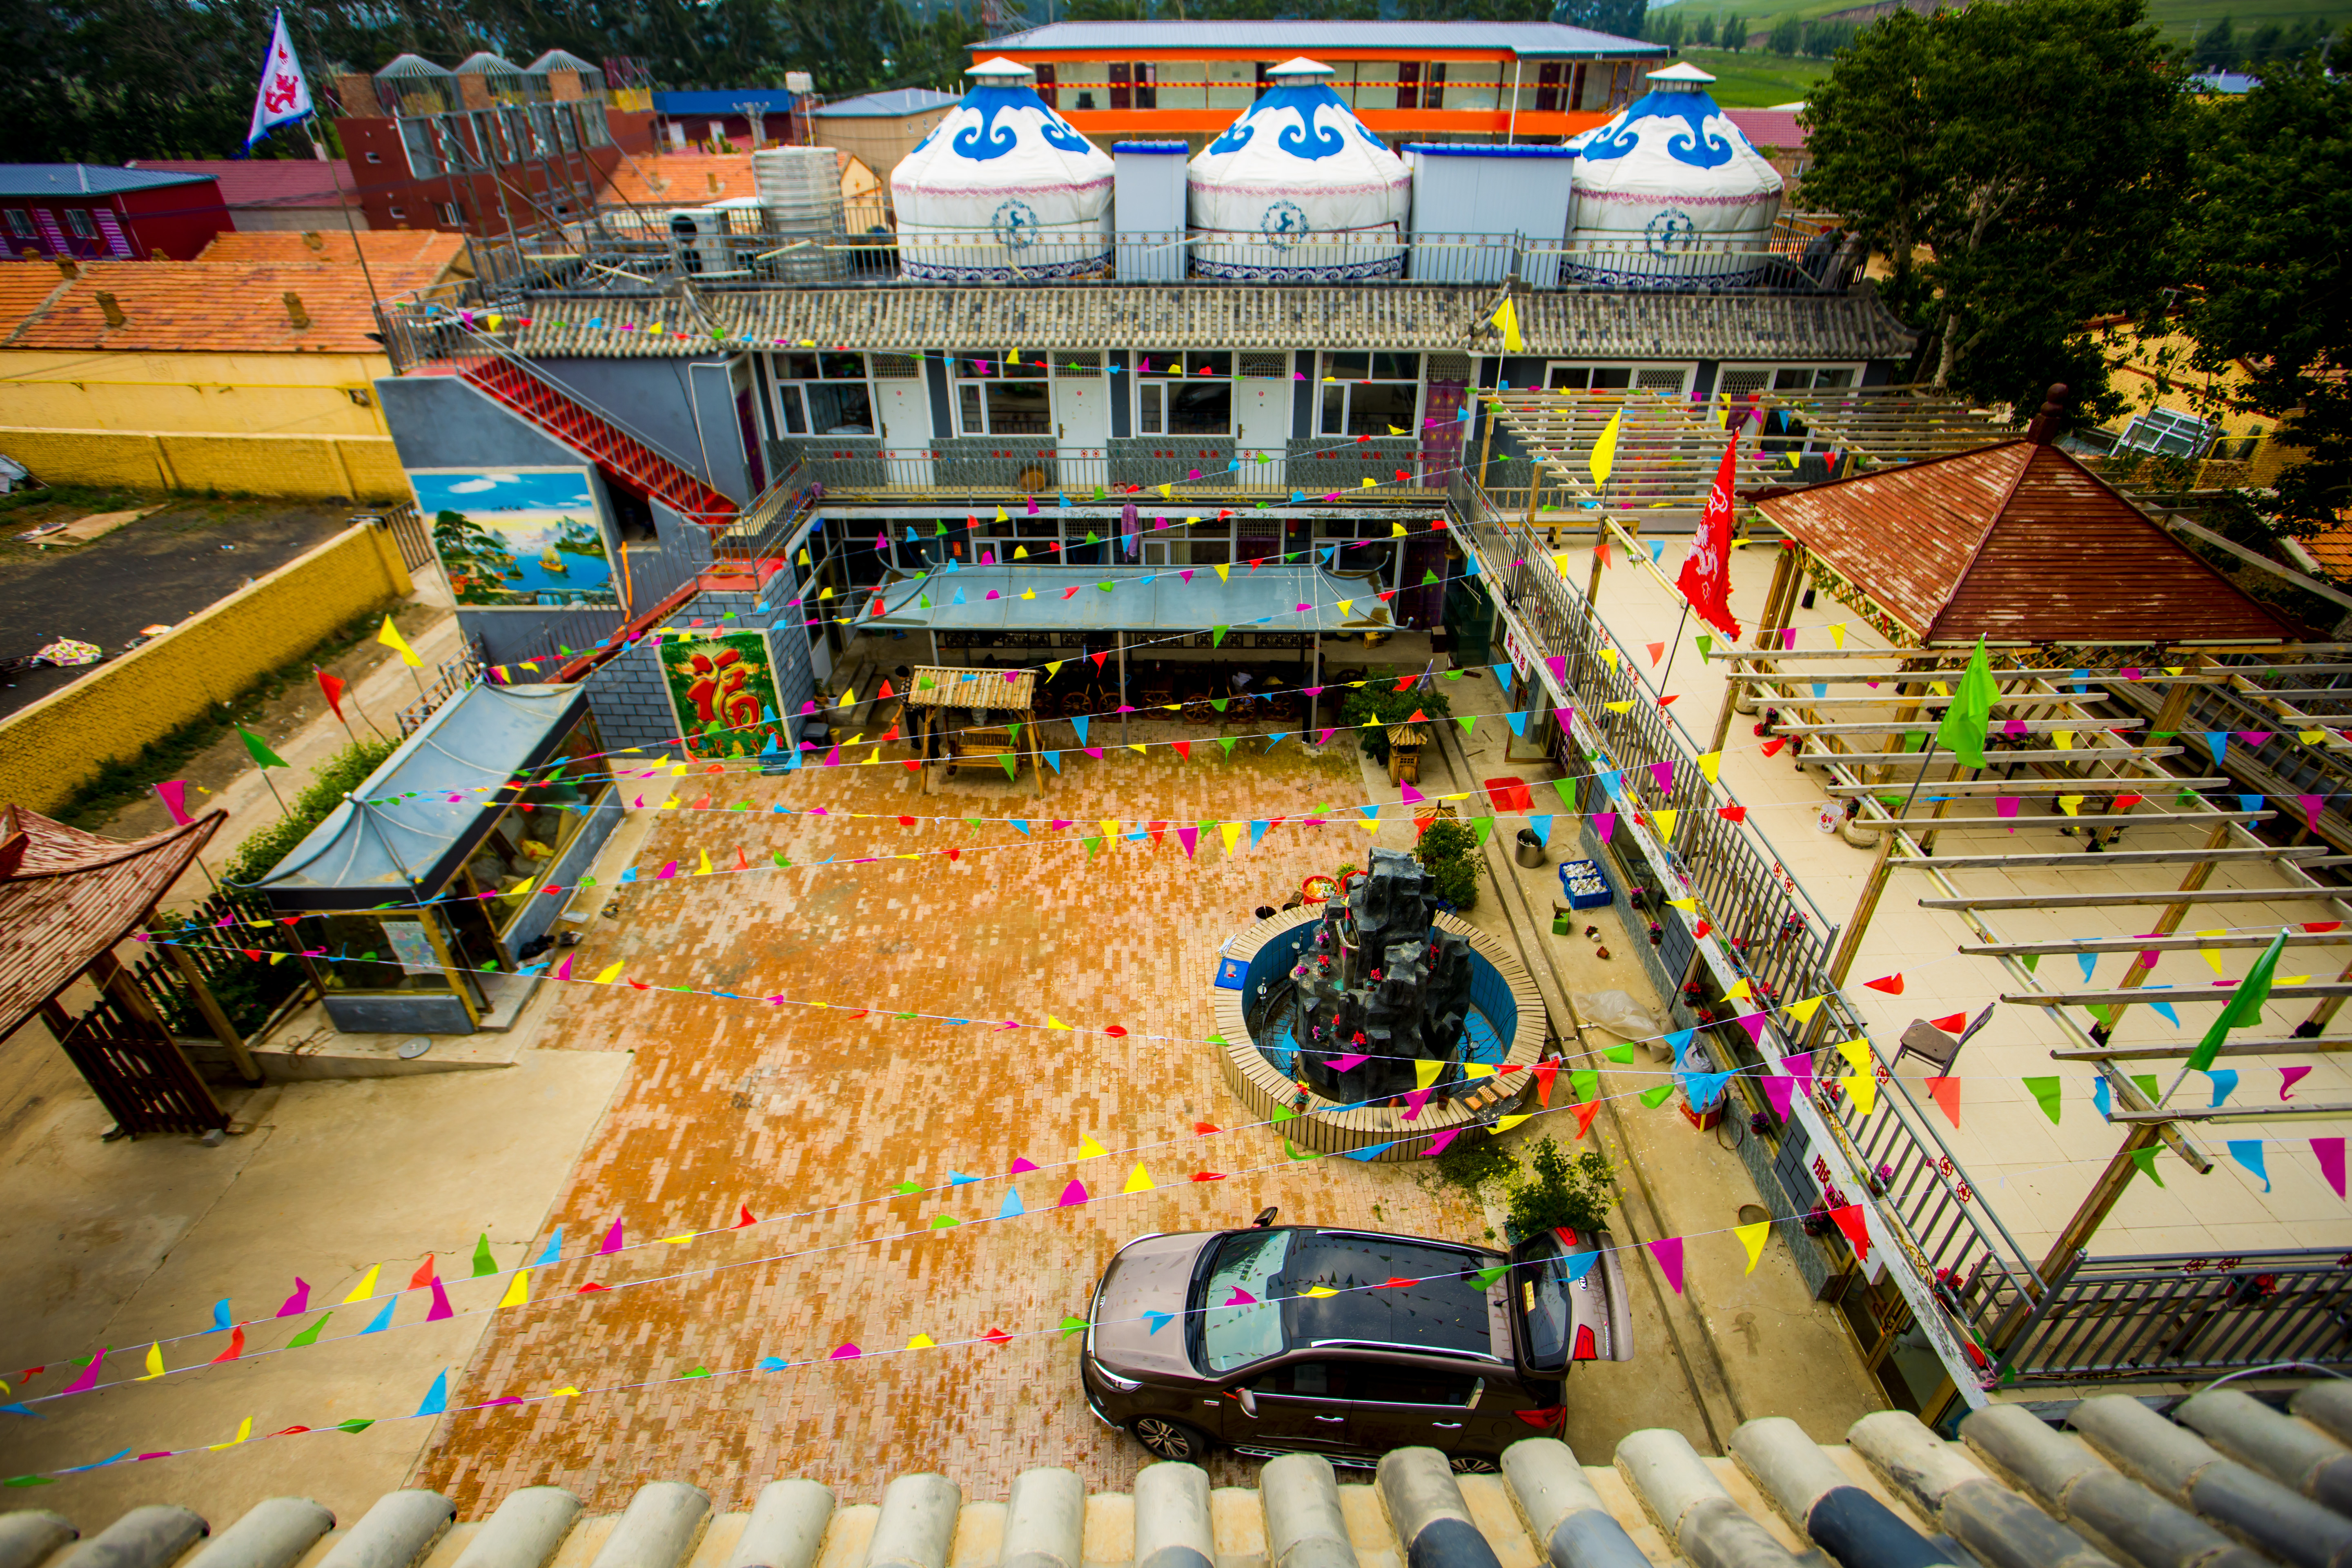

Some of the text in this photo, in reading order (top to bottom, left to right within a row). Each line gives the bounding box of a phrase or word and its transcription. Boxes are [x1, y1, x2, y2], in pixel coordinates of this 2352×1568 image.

[1508, 632, 1526, 671] 餐饮部
[686, 648, 760, 734] 福
